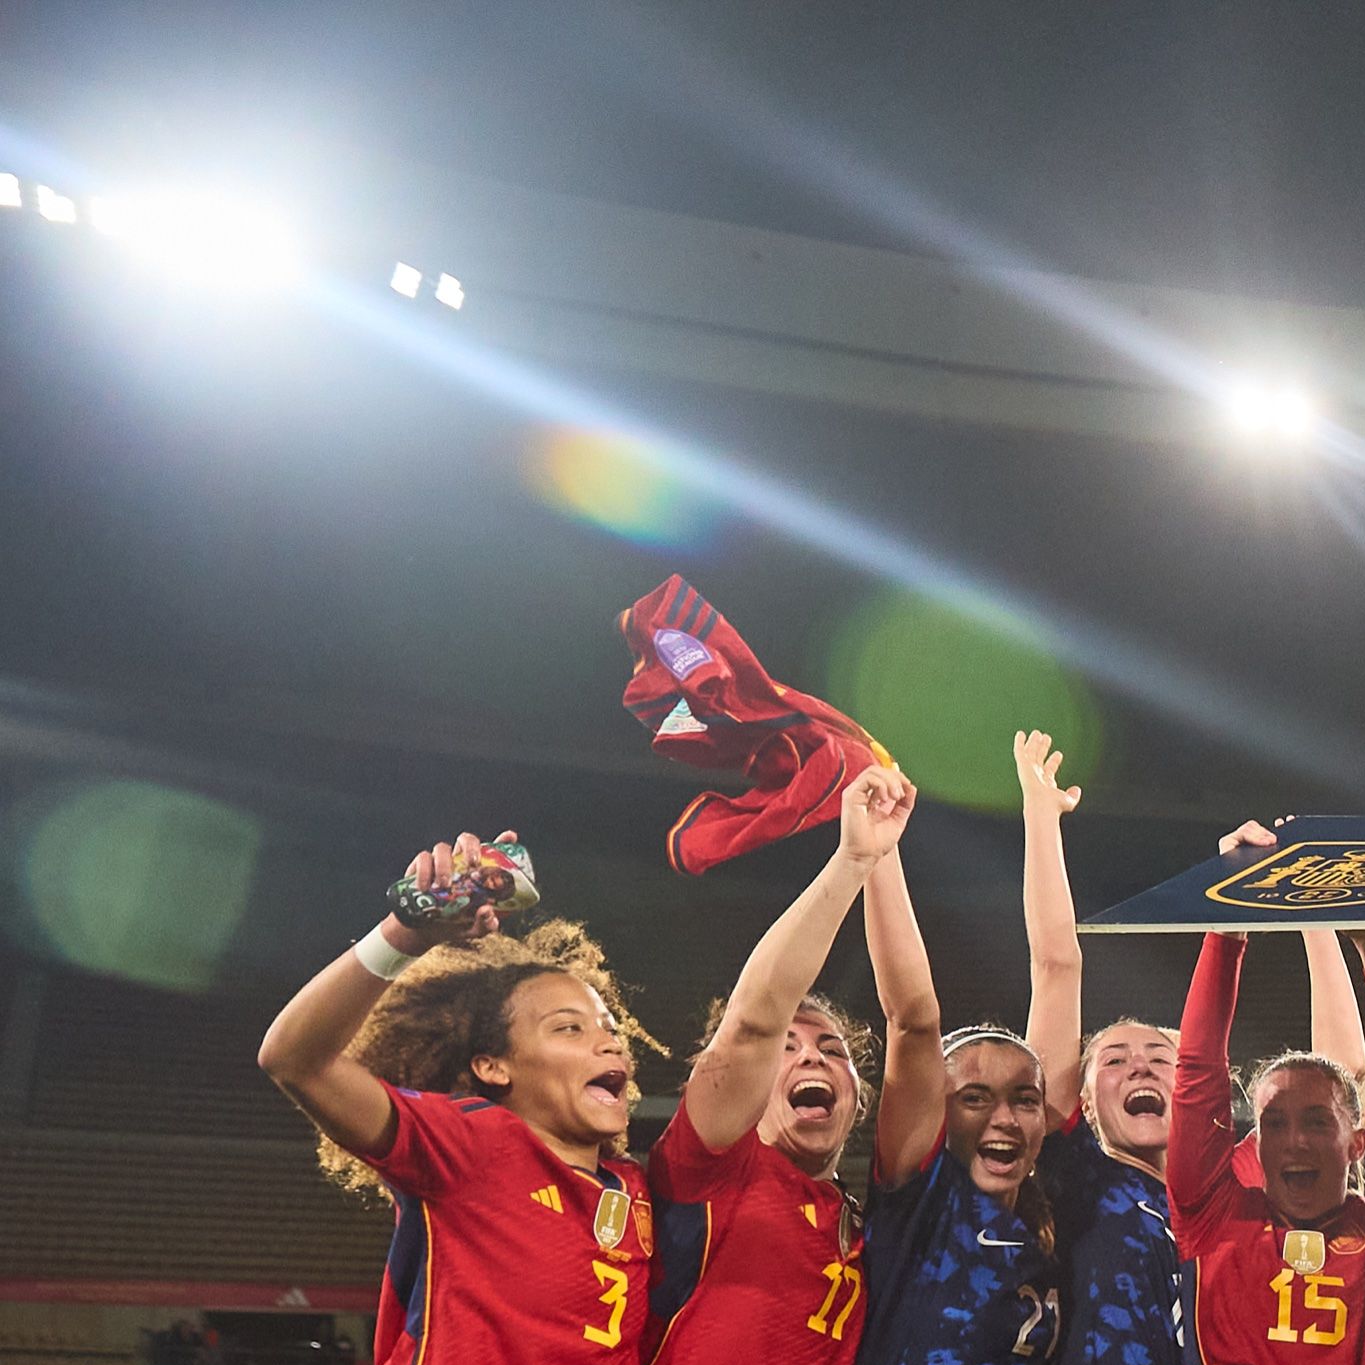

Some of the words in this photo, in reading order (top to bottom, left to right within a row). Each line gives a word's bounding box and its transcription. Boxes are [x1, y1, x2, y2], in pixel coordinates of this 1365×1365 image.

[583, 1260, 630, 1349] 3
[1012, 1284, 1061, 1359] 21
[1267, 1268, 1348, 1345] 15
